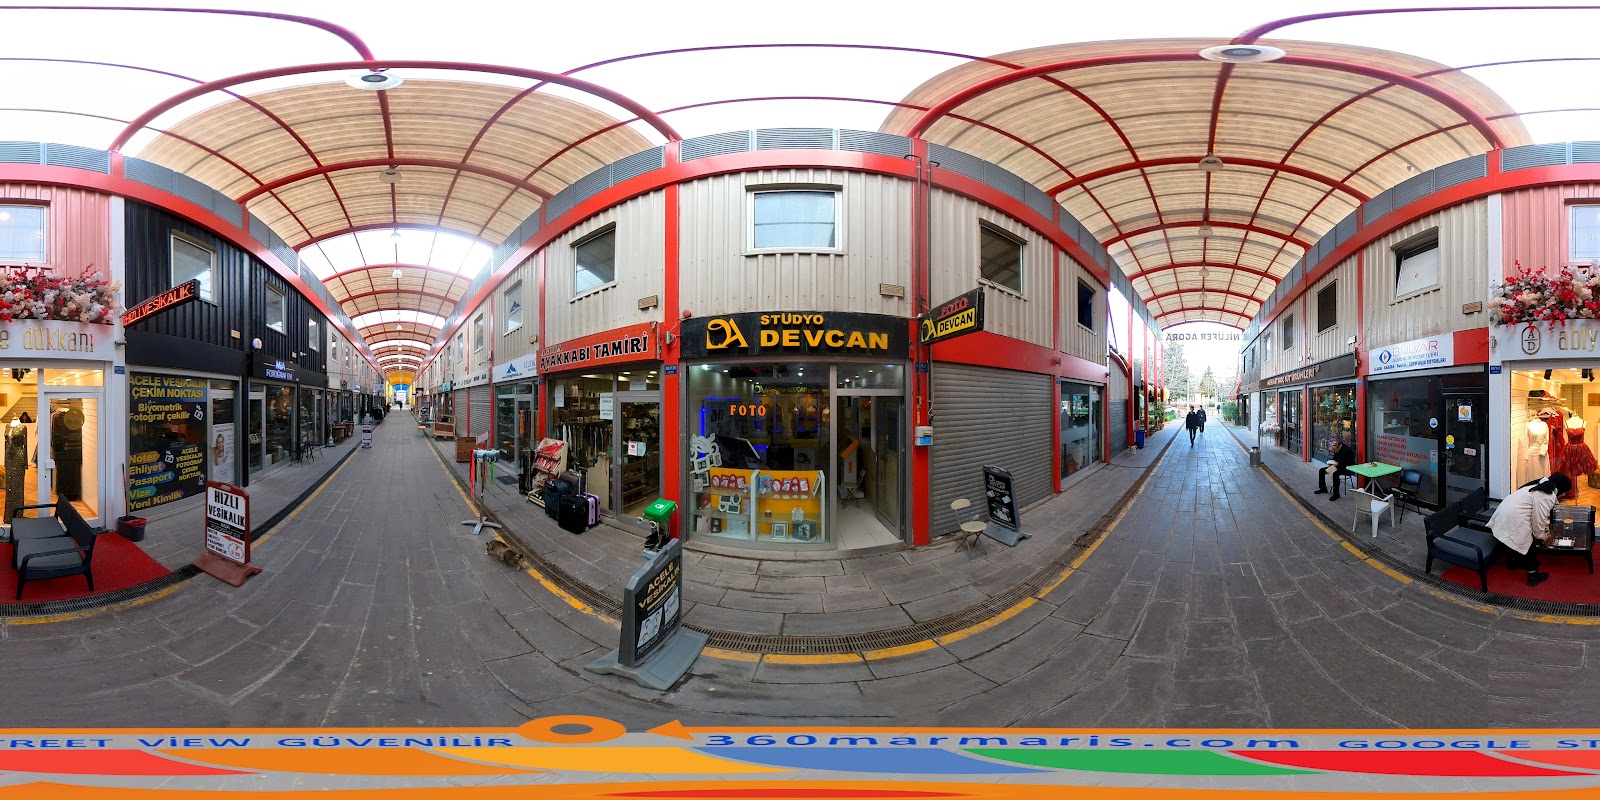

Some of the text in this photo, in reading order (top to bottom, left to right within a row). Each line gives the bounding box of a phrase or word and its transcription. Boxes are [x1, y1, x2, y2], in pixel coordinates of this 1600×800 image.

[760, 313, 824, 326] STÜDYO
[939, 311, 973, 333] DEVCAN
[760, 330, 889, 350] DEVCAN
[540, 347, 590, 372] AYAKKABI
[593, 332, 649, 359] TAMİRİ
[1392, 340, 1438, 357] BULVAR
[129, 376, 161, 386] ACELE
[132, 386, 204, 399] ÇEKİM NOKTASI
[138, 402, 182, 414] Biyometrik
[730, 404, 767, 417] FOTO
[167, 411, 190, 421] çekilir
[130, 454, 157, 464] Noter
[130, 463, 163, 476] Ehliyet
[130, 472, 172, 487] Pasaport
[130, 489, 151, 499] Vize
[130, 490, 182, 510] Yeni Kimlik
[214, 490, 239, 510] HIZLI
[208, 504, 245, 527] VESİKALIK
[647, 561, 674, 594] ACELE
